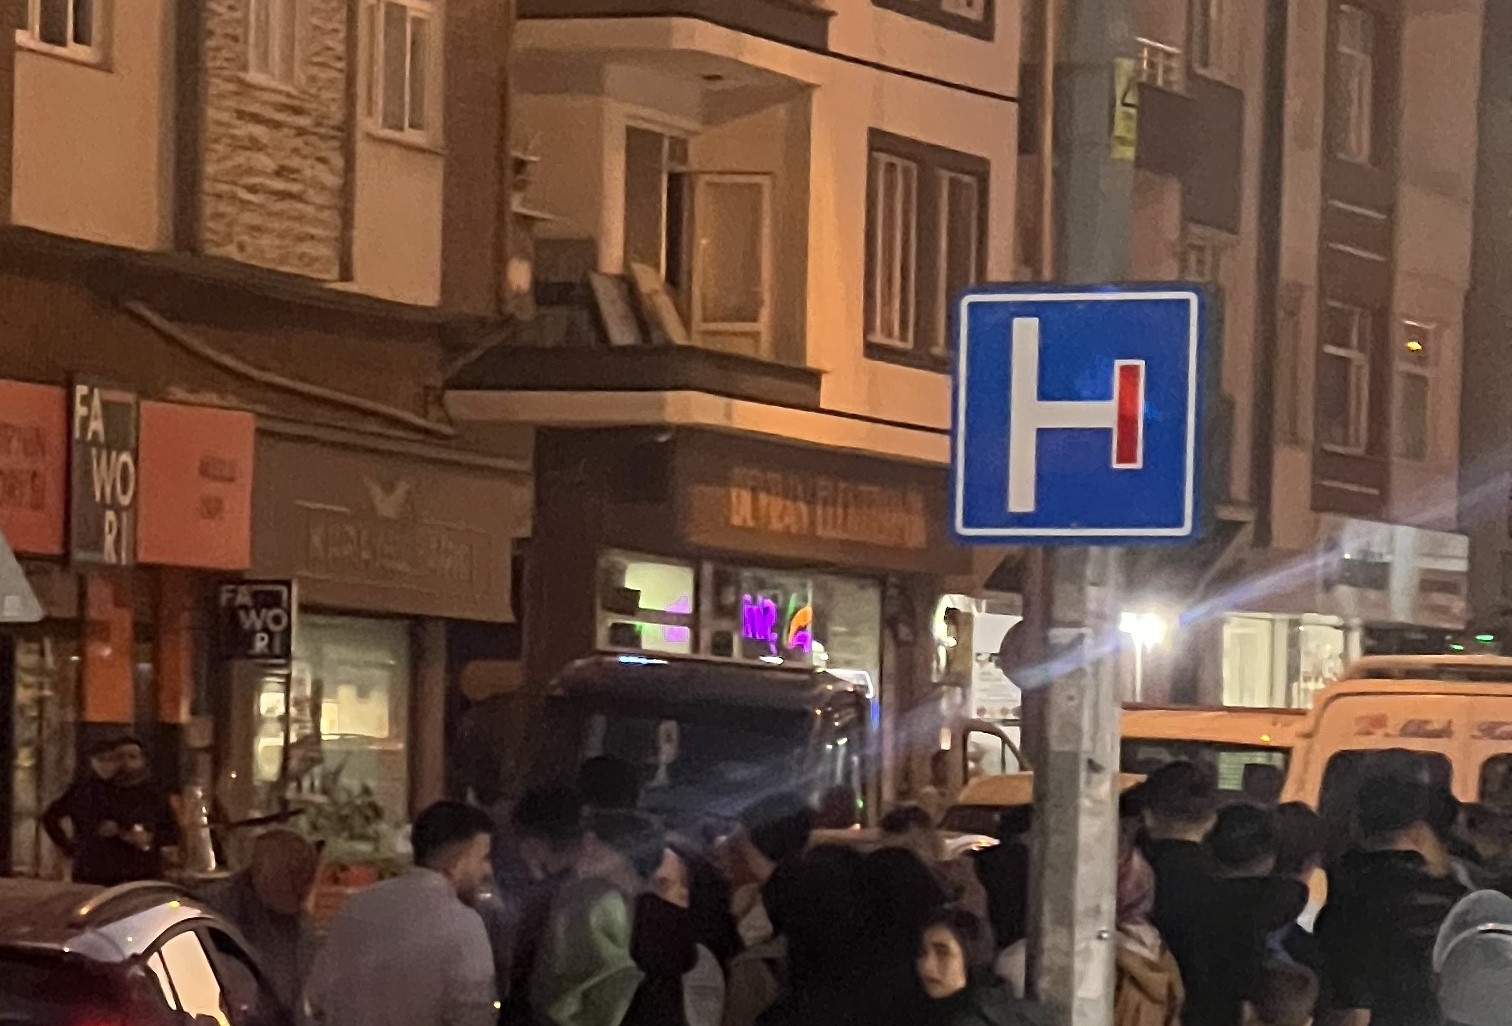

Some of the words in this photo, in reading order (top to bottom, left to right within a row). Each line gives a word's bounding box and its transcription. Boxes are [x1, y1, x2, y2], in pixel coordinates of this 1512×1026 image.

[75, 384, 105, 443] FA
[92, 446, 135, 506] WO
[103, 510, 128, 565] RI
[220, 585, 253, 607] FA
[239, 607, 288, 632] WO
